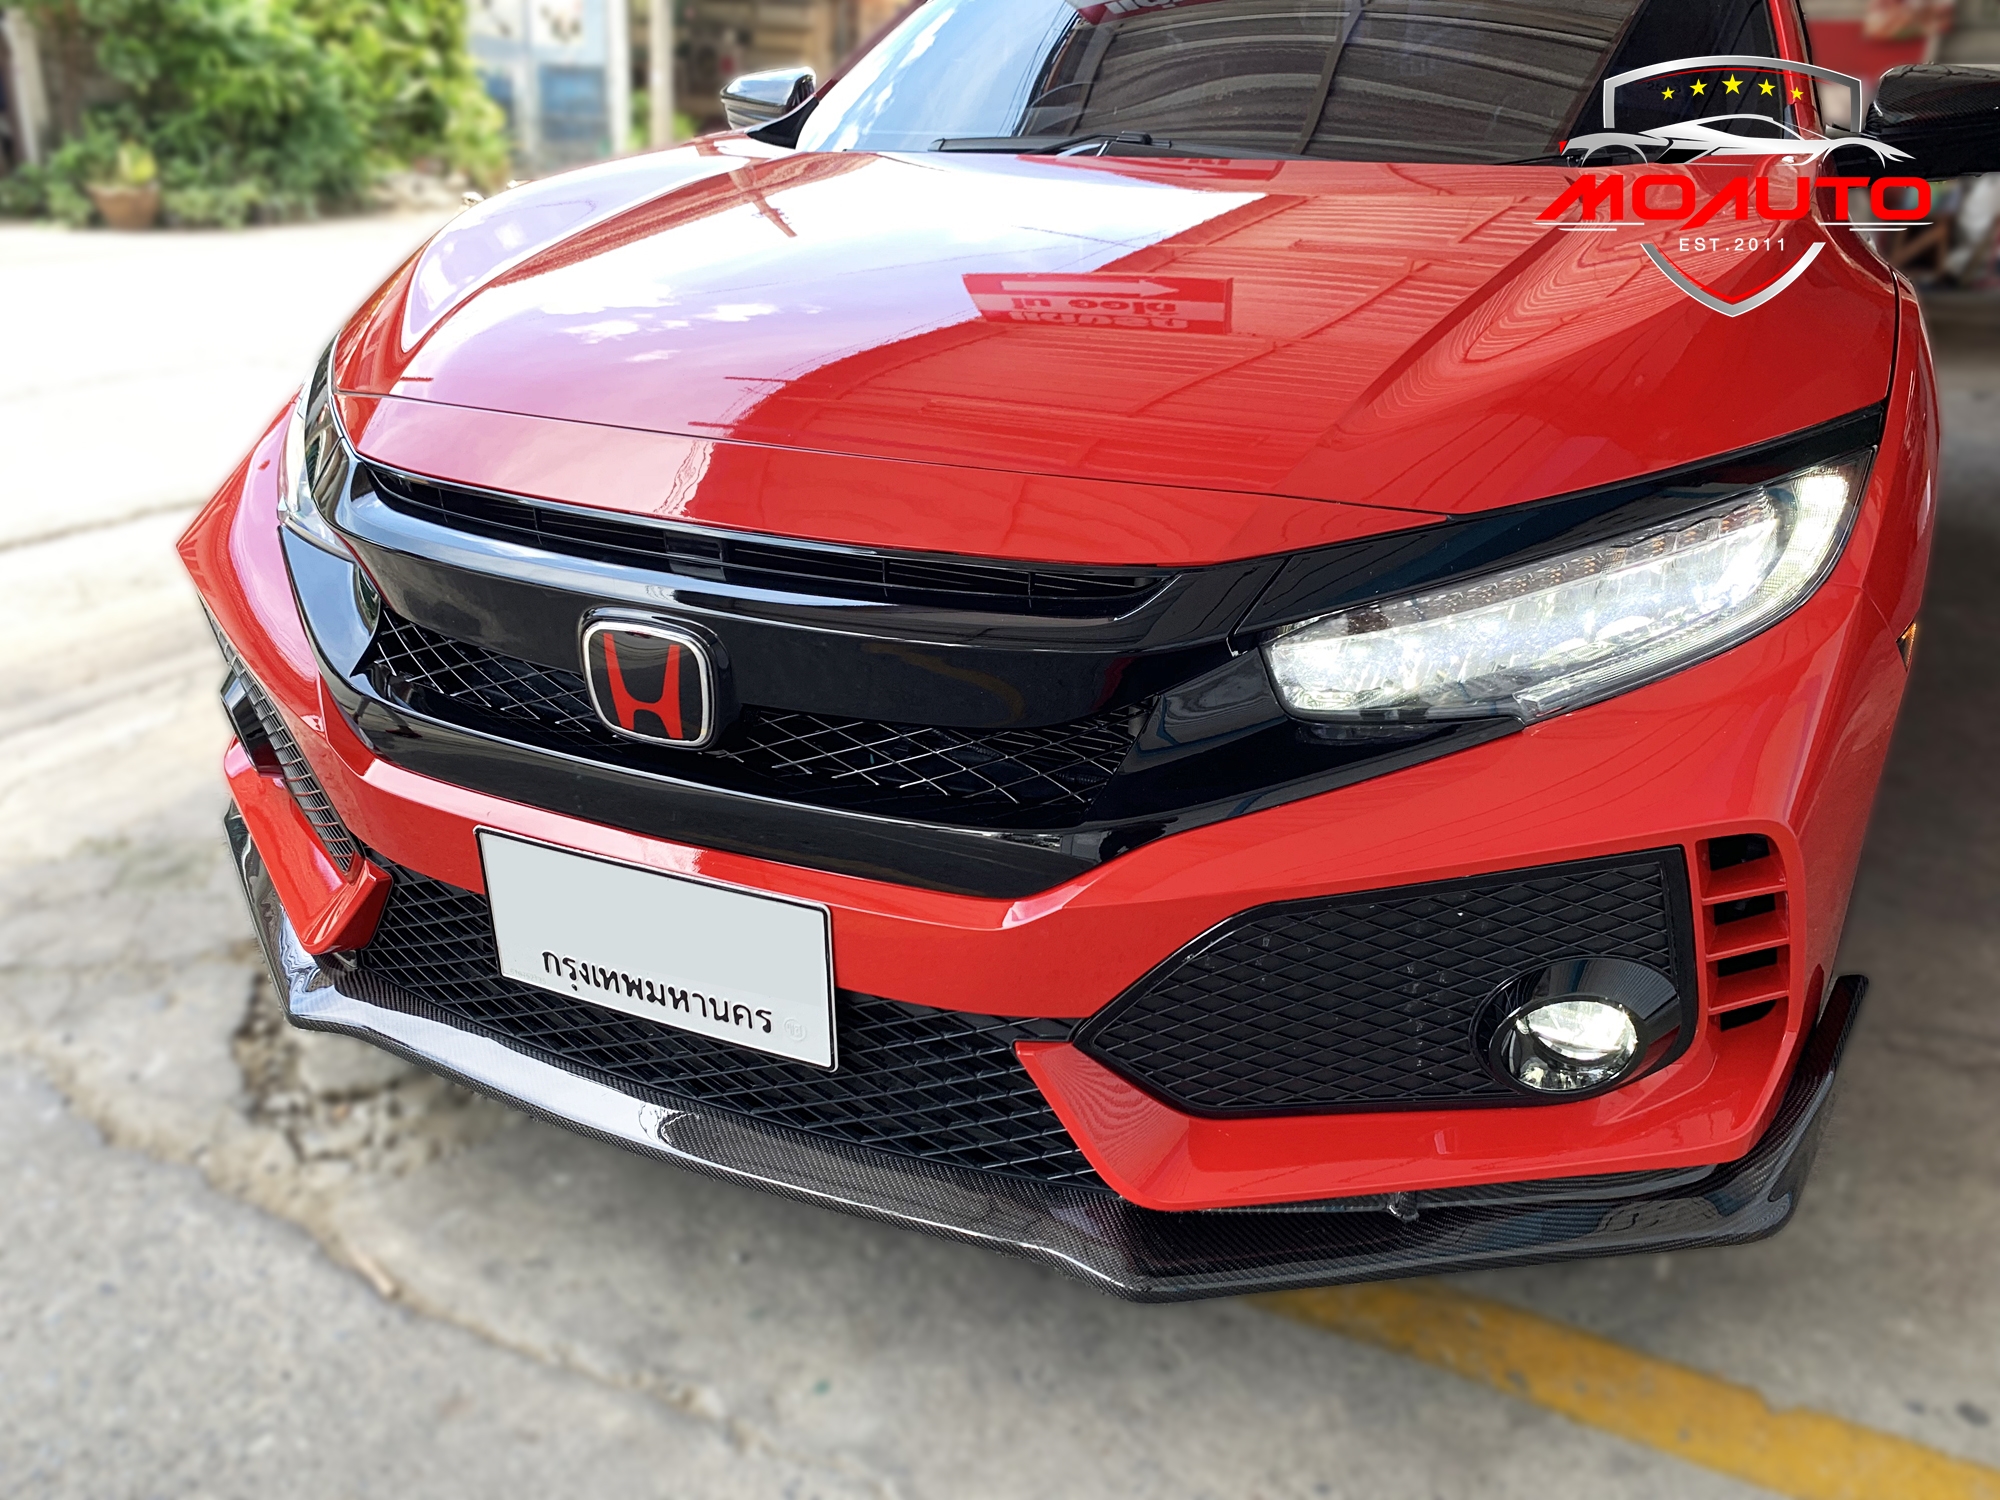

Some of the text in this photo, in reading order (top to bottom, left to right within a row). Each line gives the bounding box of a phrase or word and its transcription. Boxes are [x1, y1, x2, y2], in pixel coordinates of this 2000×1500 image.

[603, 632, 683, 739] H
[541, 950, 774, 1034] กรุงเทพมหานคร
